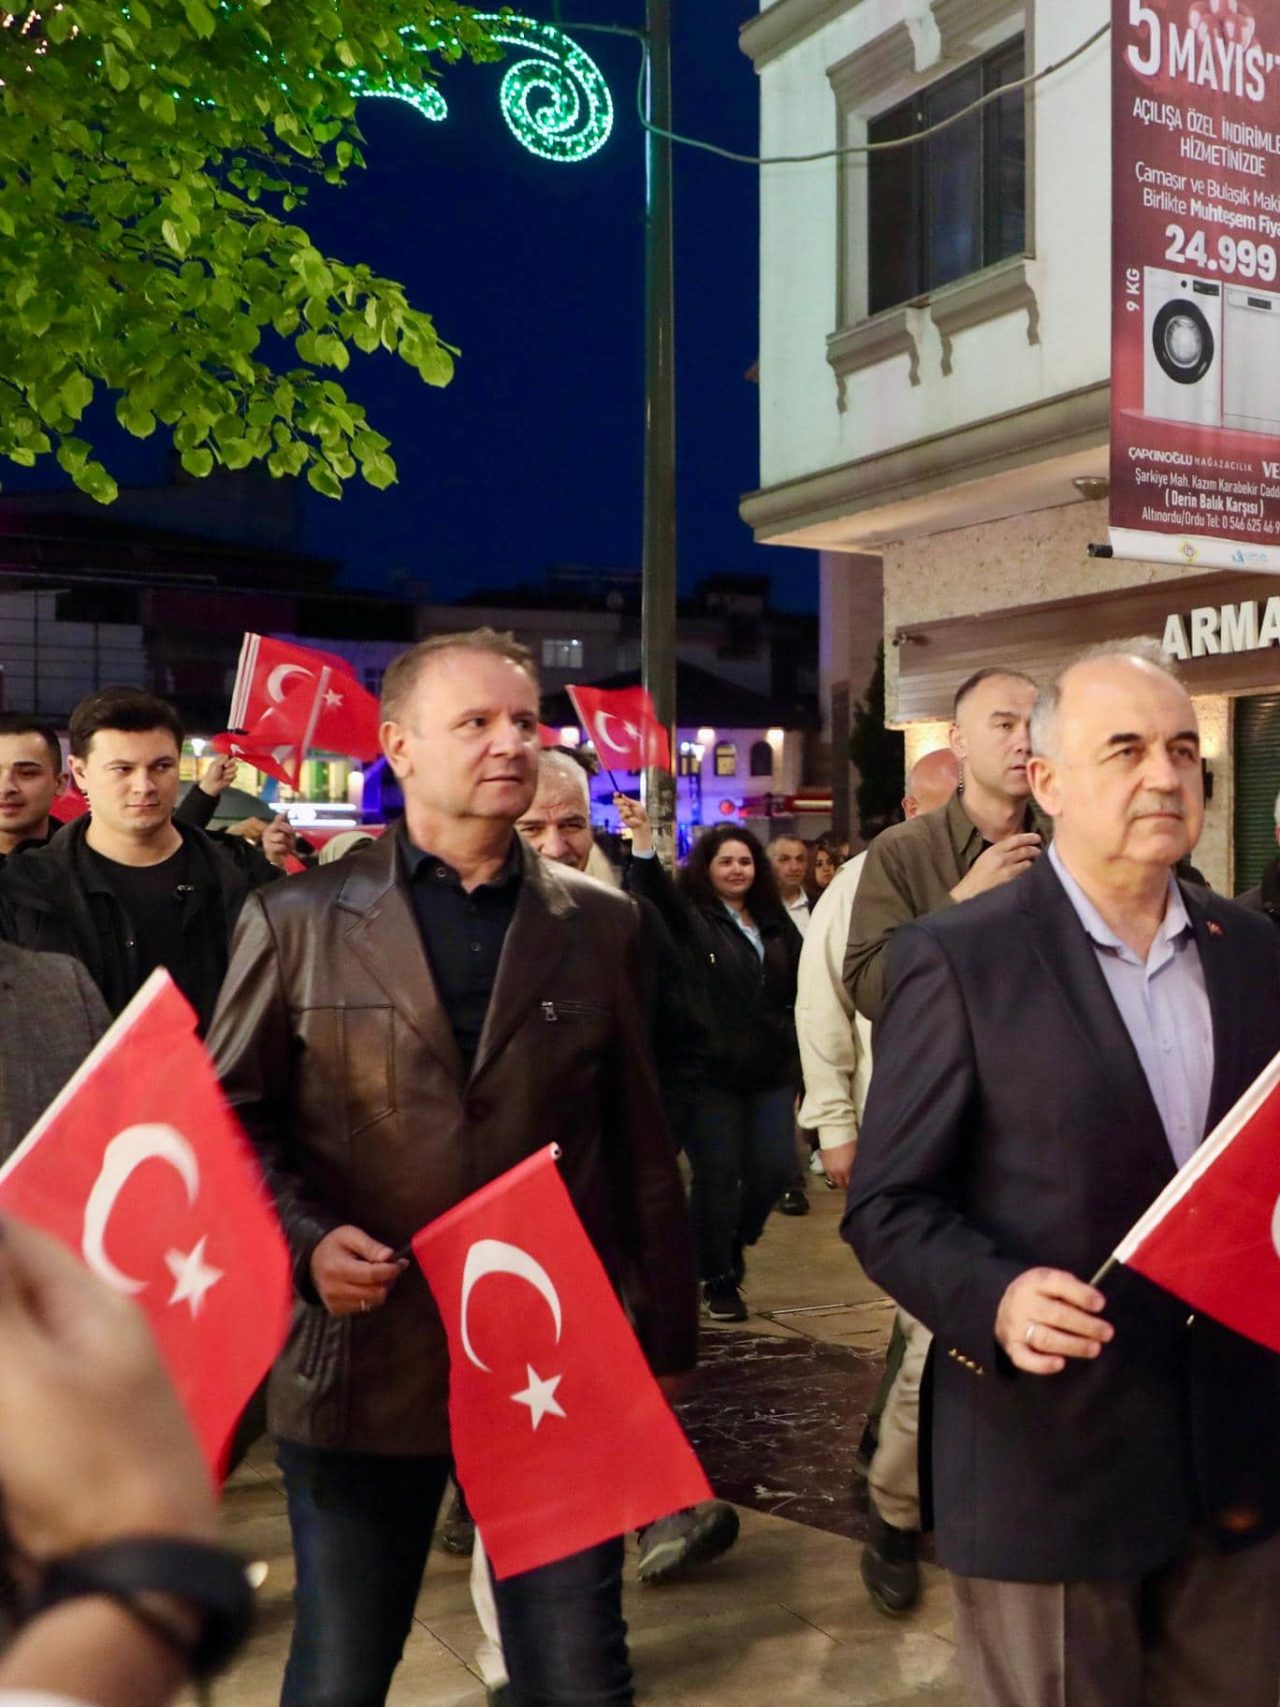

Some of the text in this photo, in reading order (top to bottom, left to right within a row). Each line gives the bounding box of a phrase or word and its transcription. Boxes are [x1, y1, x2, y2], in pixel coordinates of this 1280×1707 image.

[1127, 0, 1161, 76] 5
[1132, 97, 1182, 131] AÇILIŞA
[1187, 107, 1216, 138] ÖZEL
[1180, 136, 1266, 177] HİZMETİNİZDE
[1135, 161, 1187, 192] Çamaşır
[1190, 179, 1204, 195] ve
[1207, 182, 1250, 206] Bulaşık
[1143, 188, 1187, 215] Birlikte
[1190, 198, 1256, 232] Muhteşem
[1164, 223, 1277, 282] 24.999
[1126, 268, 1140, 312] 9 KG
[1135, 467, 1168, 488] Şarkiye
[1170, 472, 1190, 488] Mah.
[1218, 478, 1258, 495] Karabekir
[1230, 517, 1245, 532] 546
[1247, 519, 1262, 533] 625
[1263, 520, 1274, 534] 46
